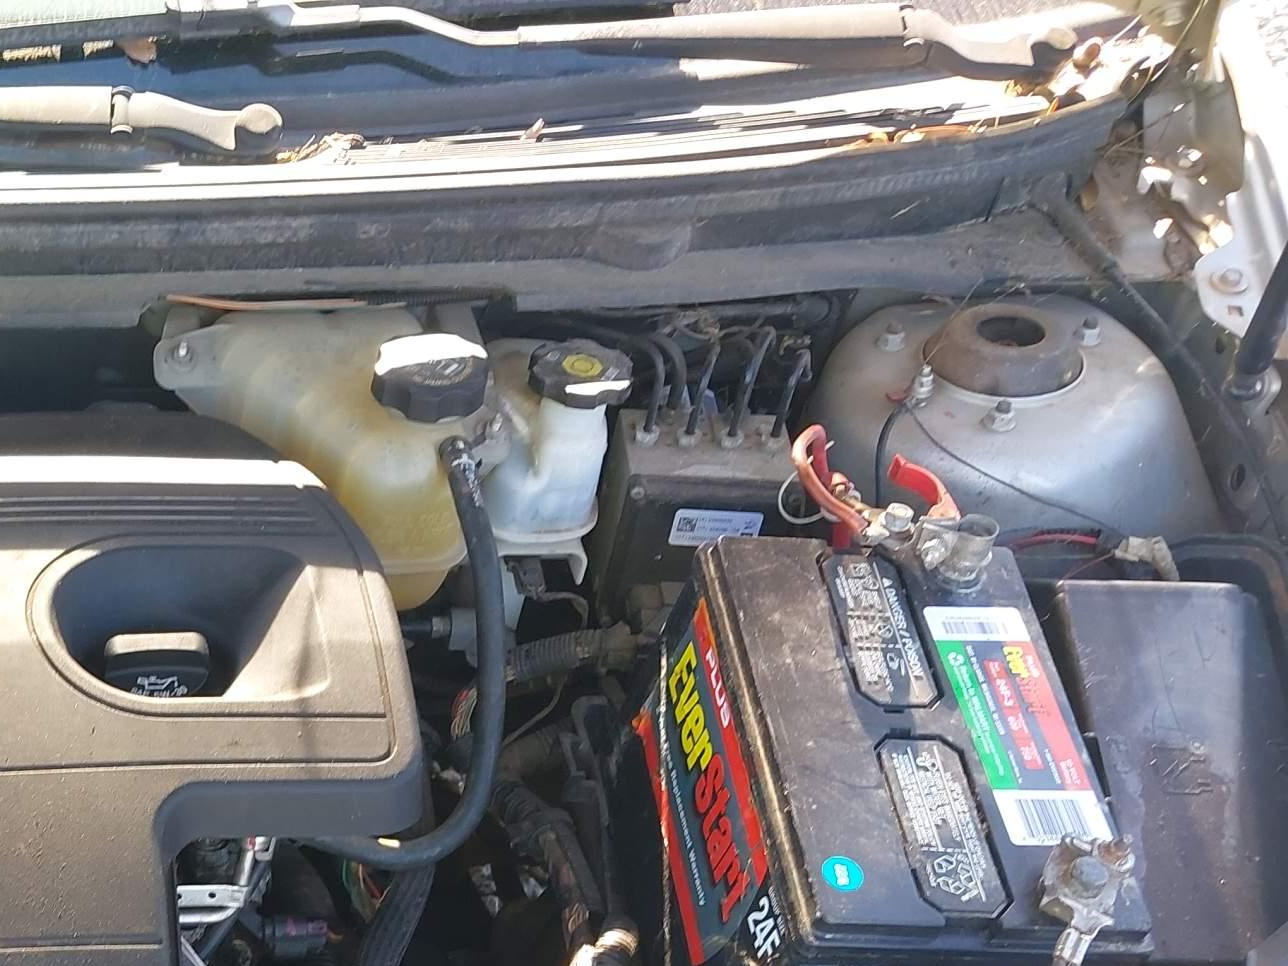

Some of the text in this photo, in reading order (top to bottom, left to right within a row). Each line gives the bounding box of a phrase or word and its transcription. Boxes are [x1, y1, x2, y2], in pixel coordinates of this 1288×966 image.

[705, 647, 731, 728] PLUS
[668, 641, 750, 923] EverStart
[670, 769, 693, 849] Replacement
[688, 848, 706, 906] Warranty
[747, 895, 781, 959] 24F
